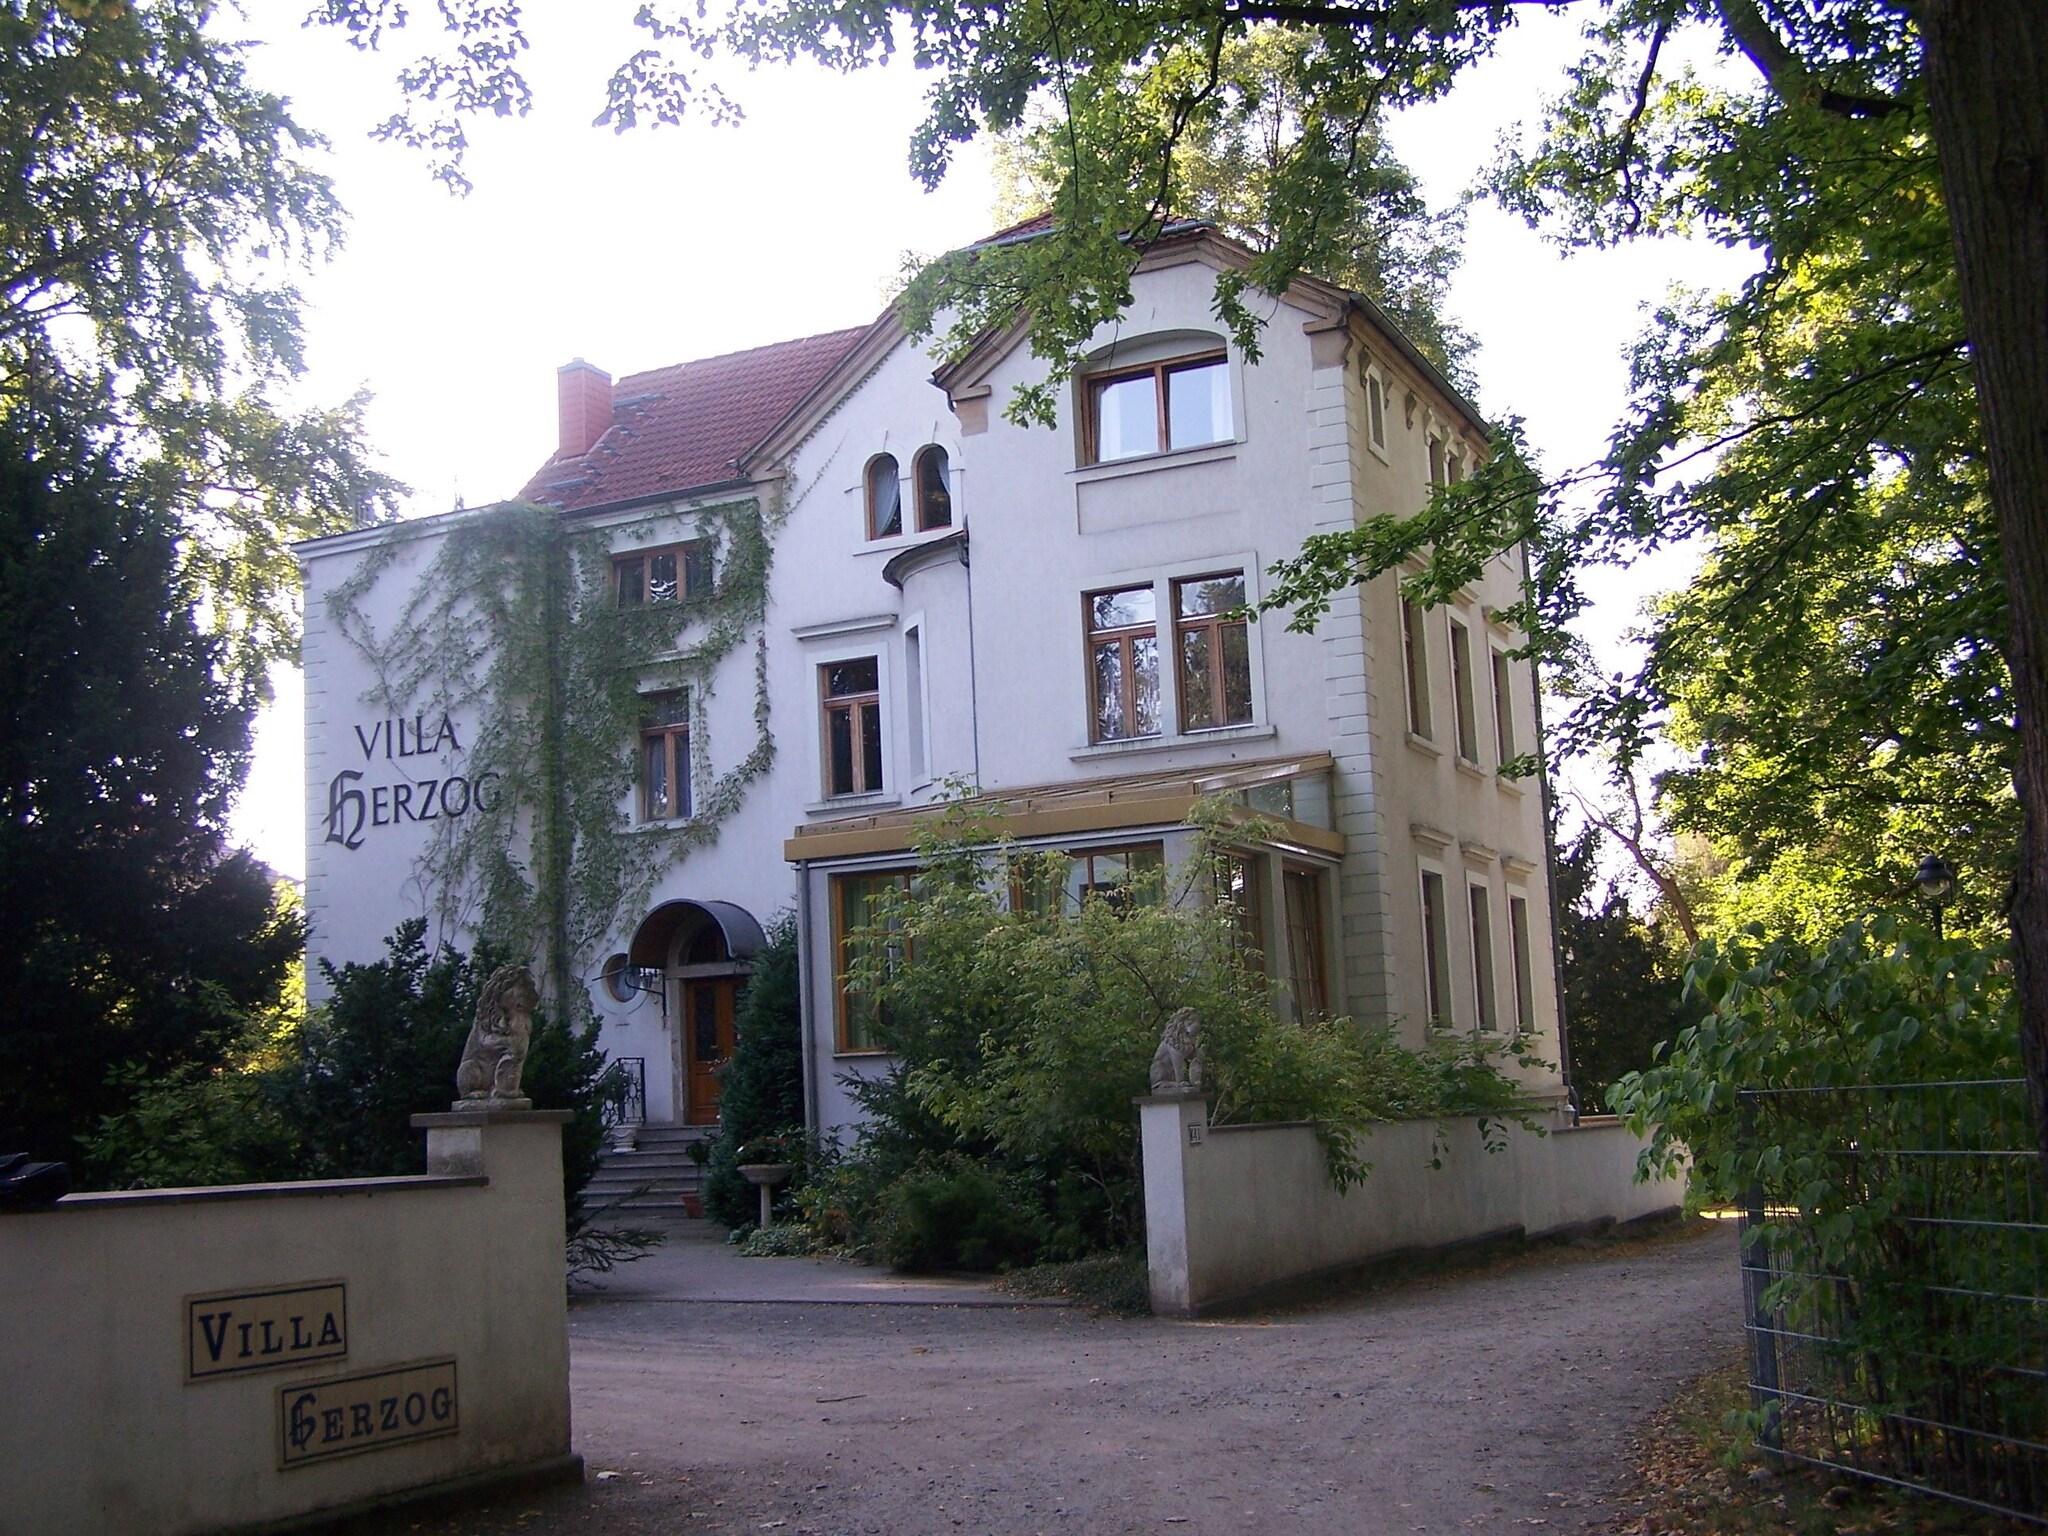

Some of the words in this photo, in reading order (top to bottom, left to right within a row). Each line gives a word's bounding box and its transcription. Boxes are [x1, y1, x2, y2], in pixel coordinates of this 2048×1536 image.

[354, 713, 462, 761] VILLA
[198, 1311, 342, 1362] VILLA
[289, 1386, 452, 1450] HERZOG
